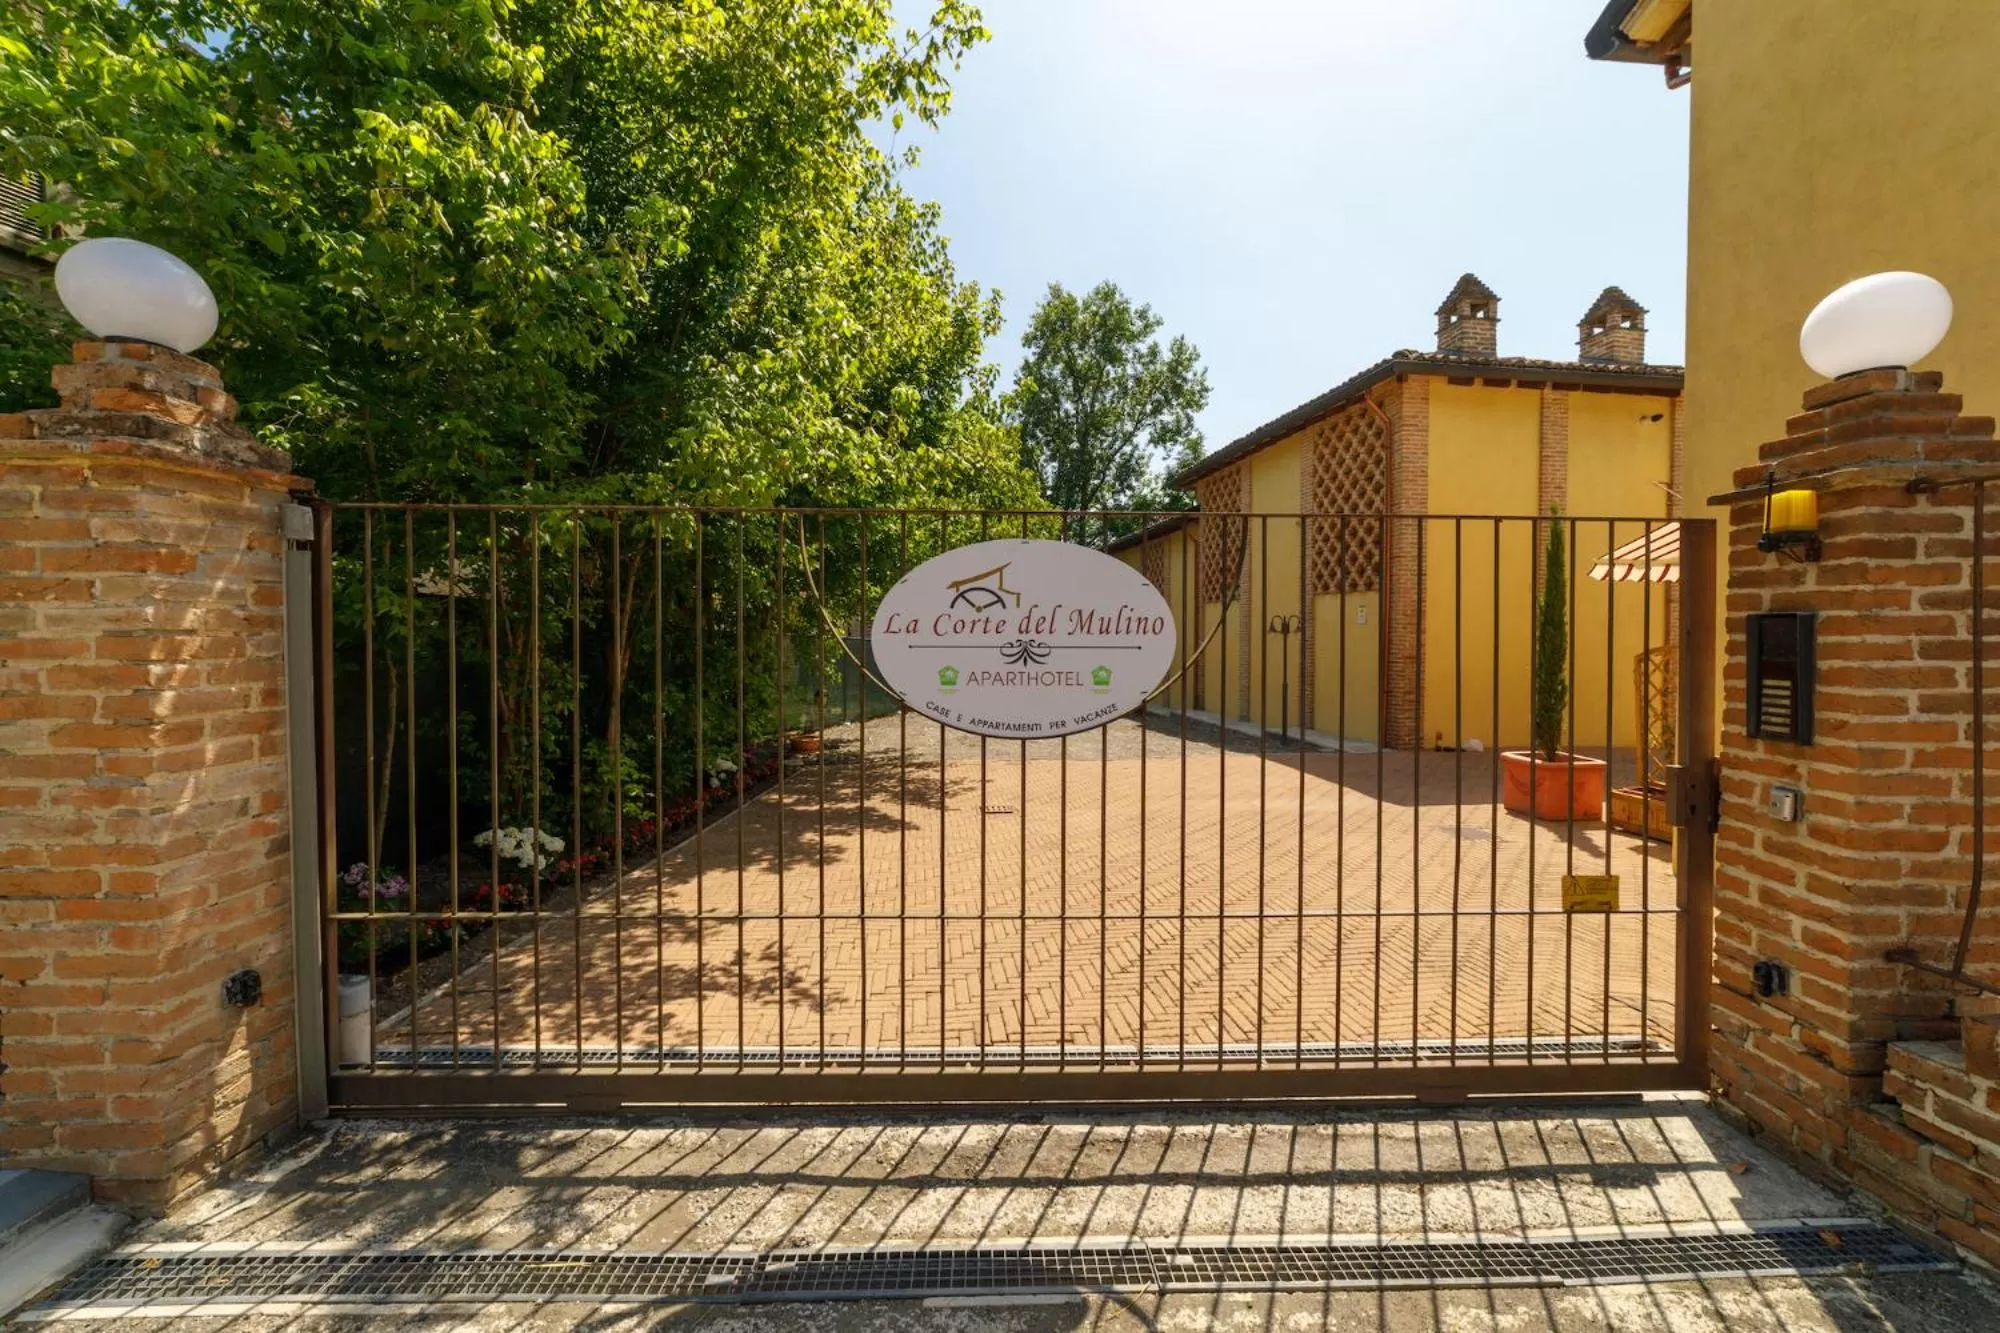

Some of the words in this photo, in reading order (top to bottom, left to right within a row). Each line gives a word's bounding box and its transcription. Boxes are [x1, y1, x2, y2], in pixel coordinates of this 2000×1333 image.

[883, 612, 920, 634] La
[933, 612, 1007, 637] Corte
[1018, 604, 1063, 635] del
[1067, 604, 1165, 636] Mulino
[966, 671, 1084, 687] APARTHOTEL
[925, 700, 951, 719] CASE
[956, 713, 964, 722] E
[968, 717, 1042, 732] APPARTAMENTI
[1049, 720, 1067, 731] PER
[1073, 703, 1119, 725] VACANZE
